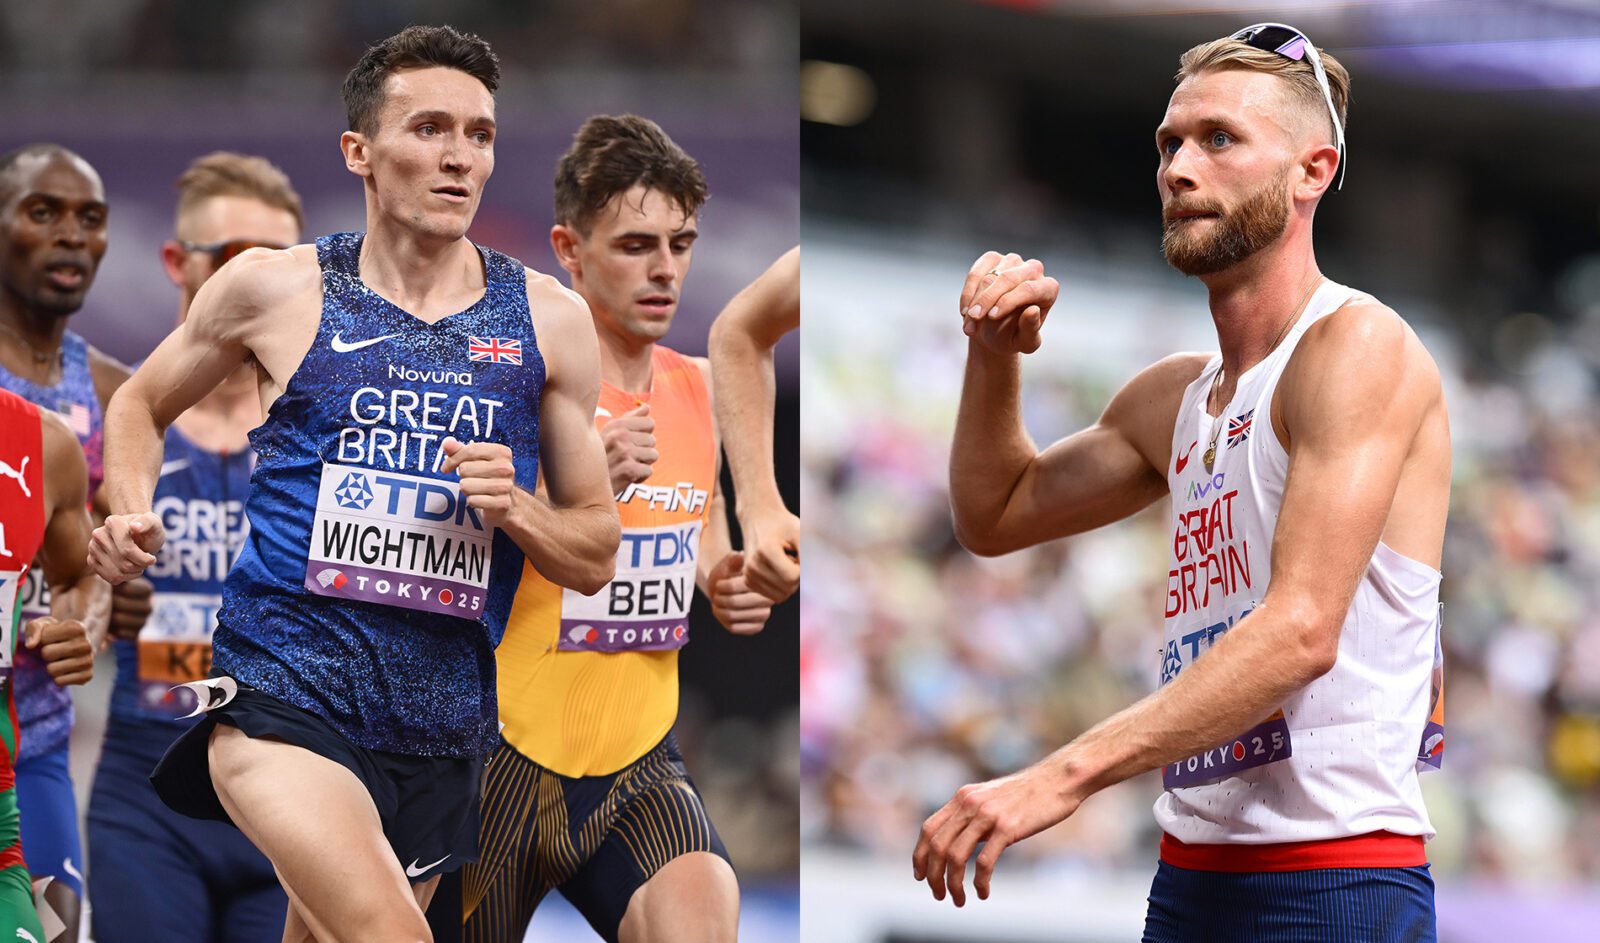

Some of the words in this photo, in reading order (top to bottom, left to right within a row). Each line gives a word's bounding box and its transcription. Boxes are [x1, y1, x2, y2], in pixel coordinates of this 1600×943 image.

[388, 364, 473, 386] Novuna
[350, 386, 504, 439] GREAT
[337, 427, 461, 474] BRIT
[614, 481, 709, 516] PAÑA
[322, 519, 486, 583] WIGHTMAN
[620, 527, 696, 569] TDK
[458, 592, 481, 611] 25
[607, 577, 685, 617] BEN
